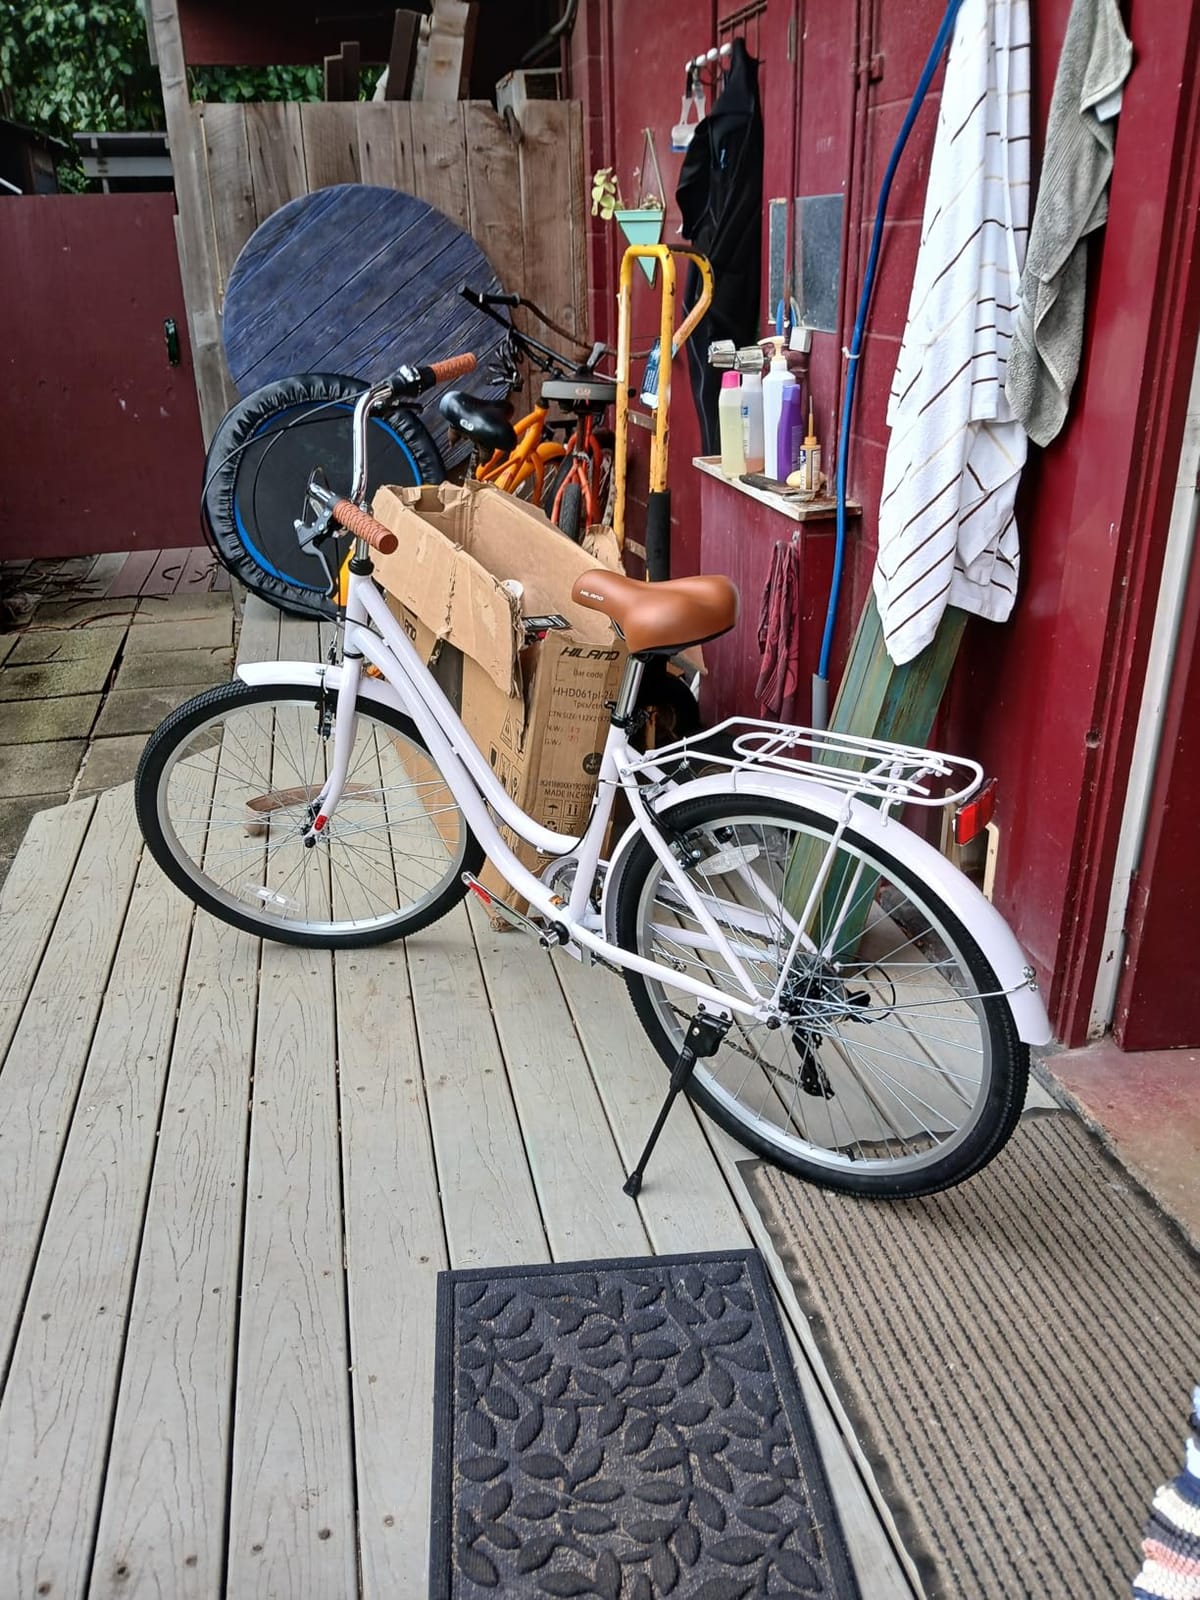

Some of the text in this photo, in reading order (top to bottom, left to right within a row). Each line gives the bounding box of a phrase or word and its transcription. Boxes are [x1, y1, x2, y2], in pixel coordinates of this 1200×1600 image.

[560, 646, 620, 661] HILAND
[573, 668, 604, 679] Bar code
[544, 788, 595, 800] MADE IN CHIN
